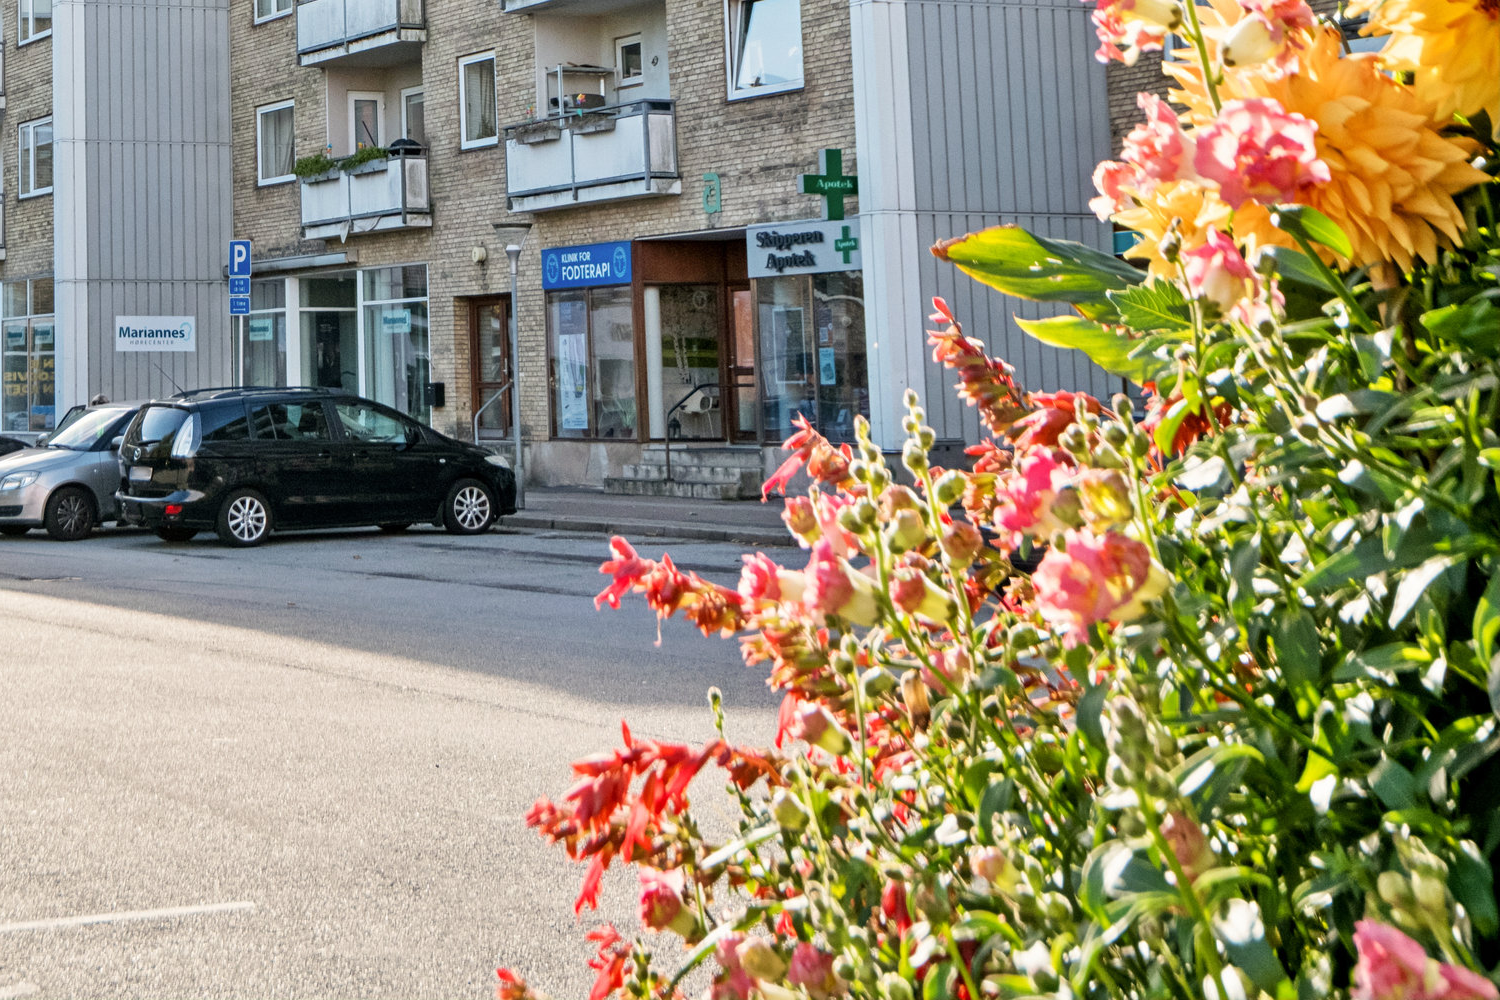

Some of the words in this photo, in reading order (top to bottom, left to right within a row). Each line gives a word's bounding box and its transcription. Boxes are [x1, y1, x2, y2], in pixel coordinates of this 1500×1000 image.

[816, 179, 853, 190] Apotek
[756, 230, 824, 250] Skipperen
[234, 245, 247, 273] P
[561, 252, 579, 264] KLINIK
[579, 247, 591, 262] FOR
[765, 250, 816, 273] Apotek
[561, 262, 611, 281] FODTERAPI
[118, 326, 185, 338] Mariannes
